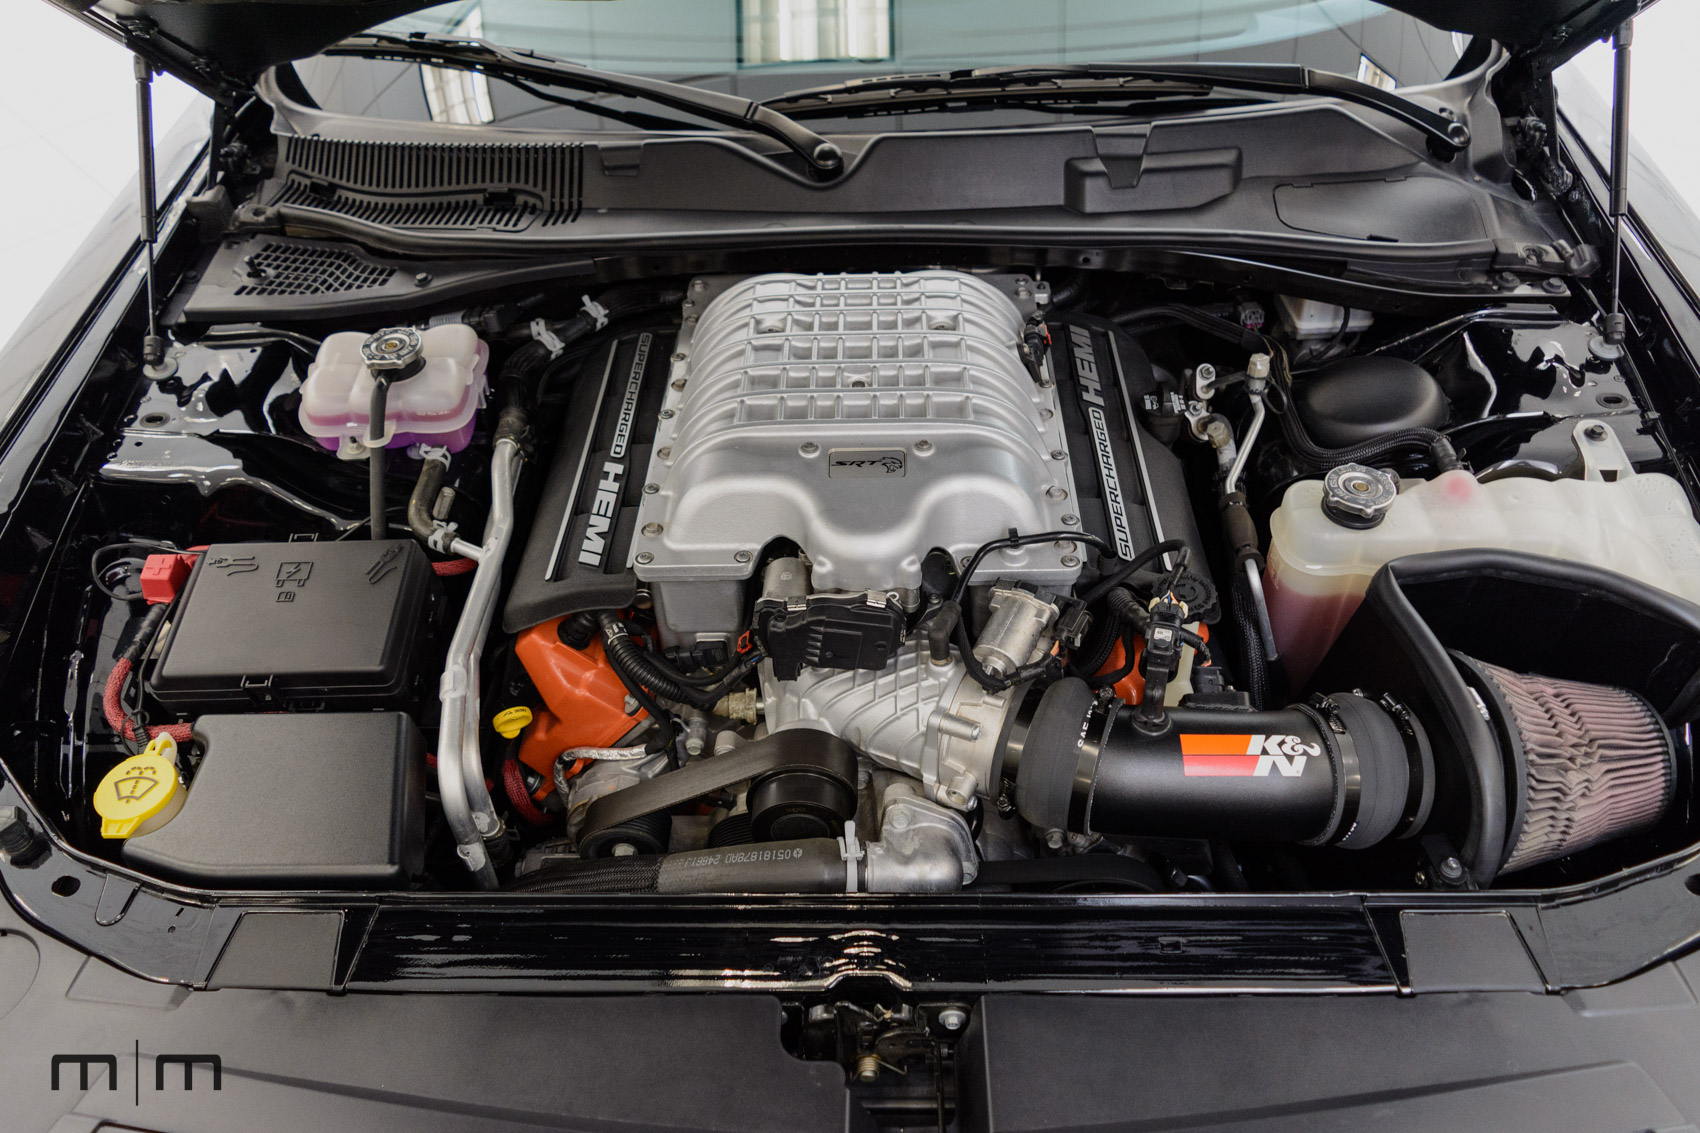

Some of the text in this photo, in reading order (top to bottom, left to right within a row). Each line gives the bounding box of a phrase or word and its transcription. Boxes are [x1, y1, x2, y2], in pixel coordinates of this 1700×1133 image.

[578, 333, 651, 567] SUPERCHARGED HEMI
[831, 460, 882, 468] SRT
[1069, 324, 1134, 560] SUPERCHARGED HEMI
